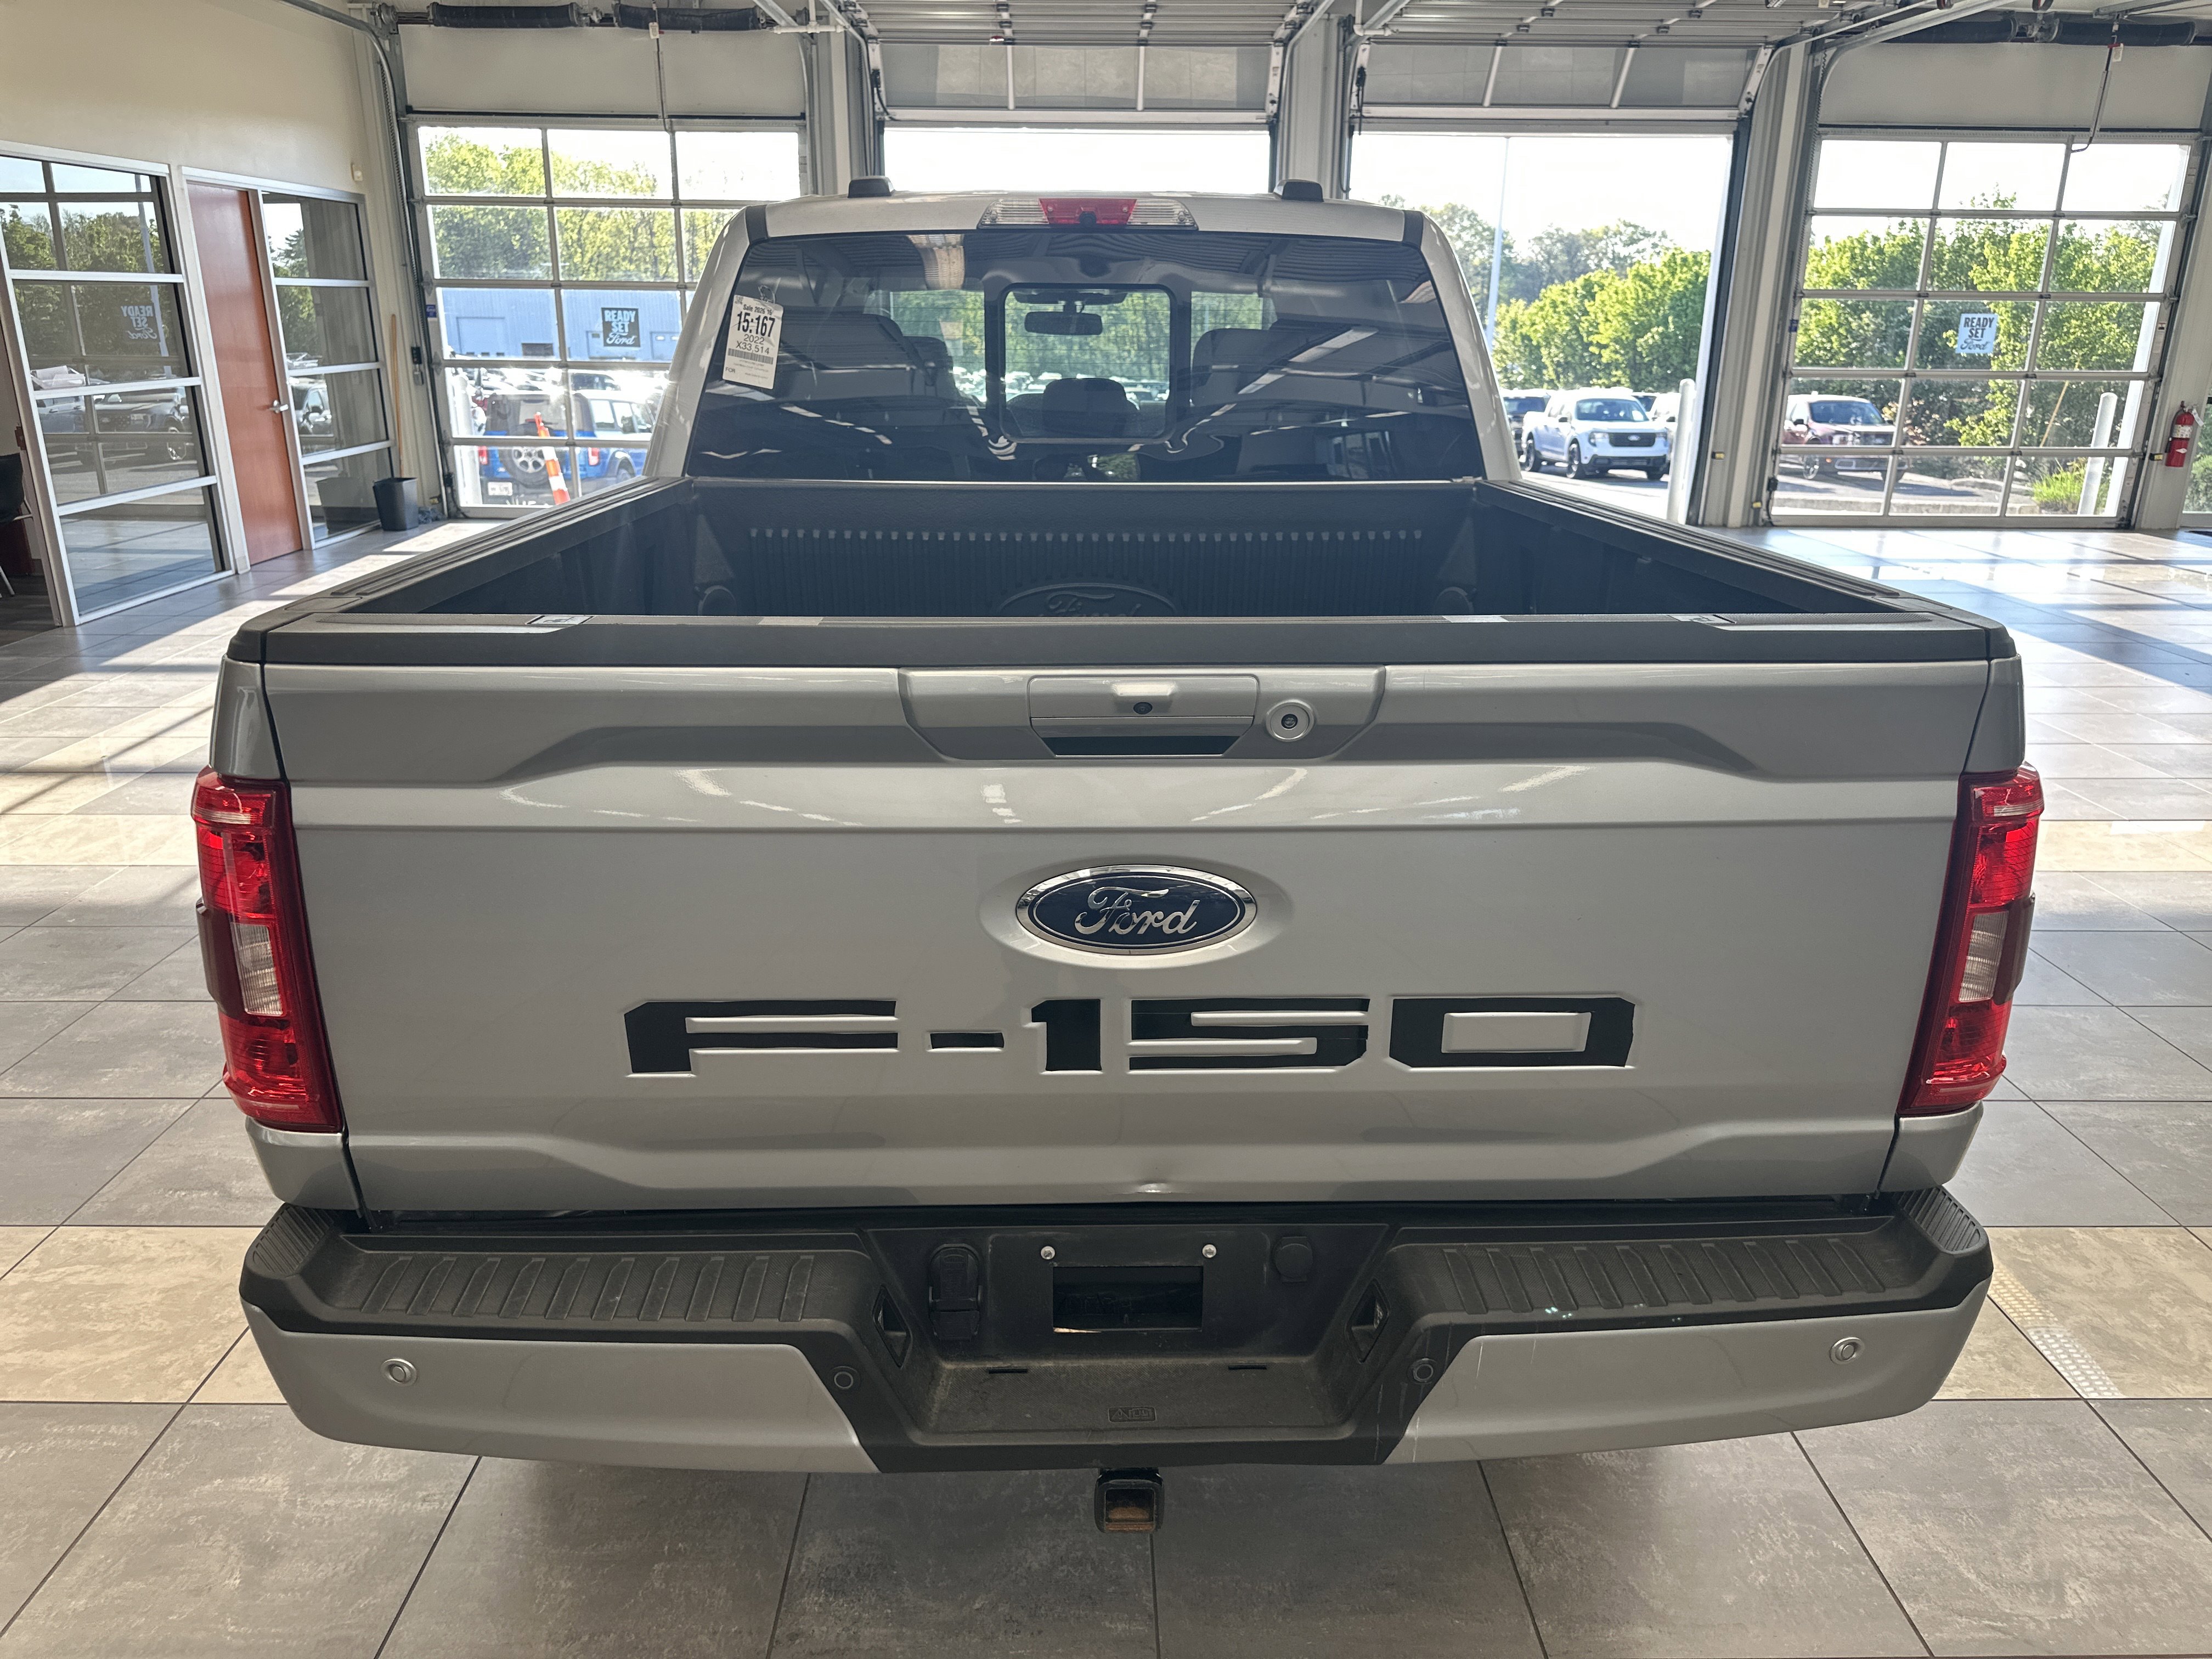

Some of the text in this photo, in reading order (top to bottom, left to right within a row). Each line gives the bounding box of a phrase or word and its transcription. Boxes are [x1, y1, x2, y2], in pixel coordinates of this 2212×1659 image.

[604, 310, 636, 322] READY
[612, 321, 629, 332] SET
[1963, 317, 1994, 328] READY
[606, 332, 637, 345] Ford
[1968, 328, 1986, 338] SET
[744, 334, 765, 345] 2022
[1960, 338, 1991, 350] Ford
[736, 341, 770, 354] X33,514
[1074, 886, 1201, 935] Ford
[624, 997, 1636, 1074] F-150
